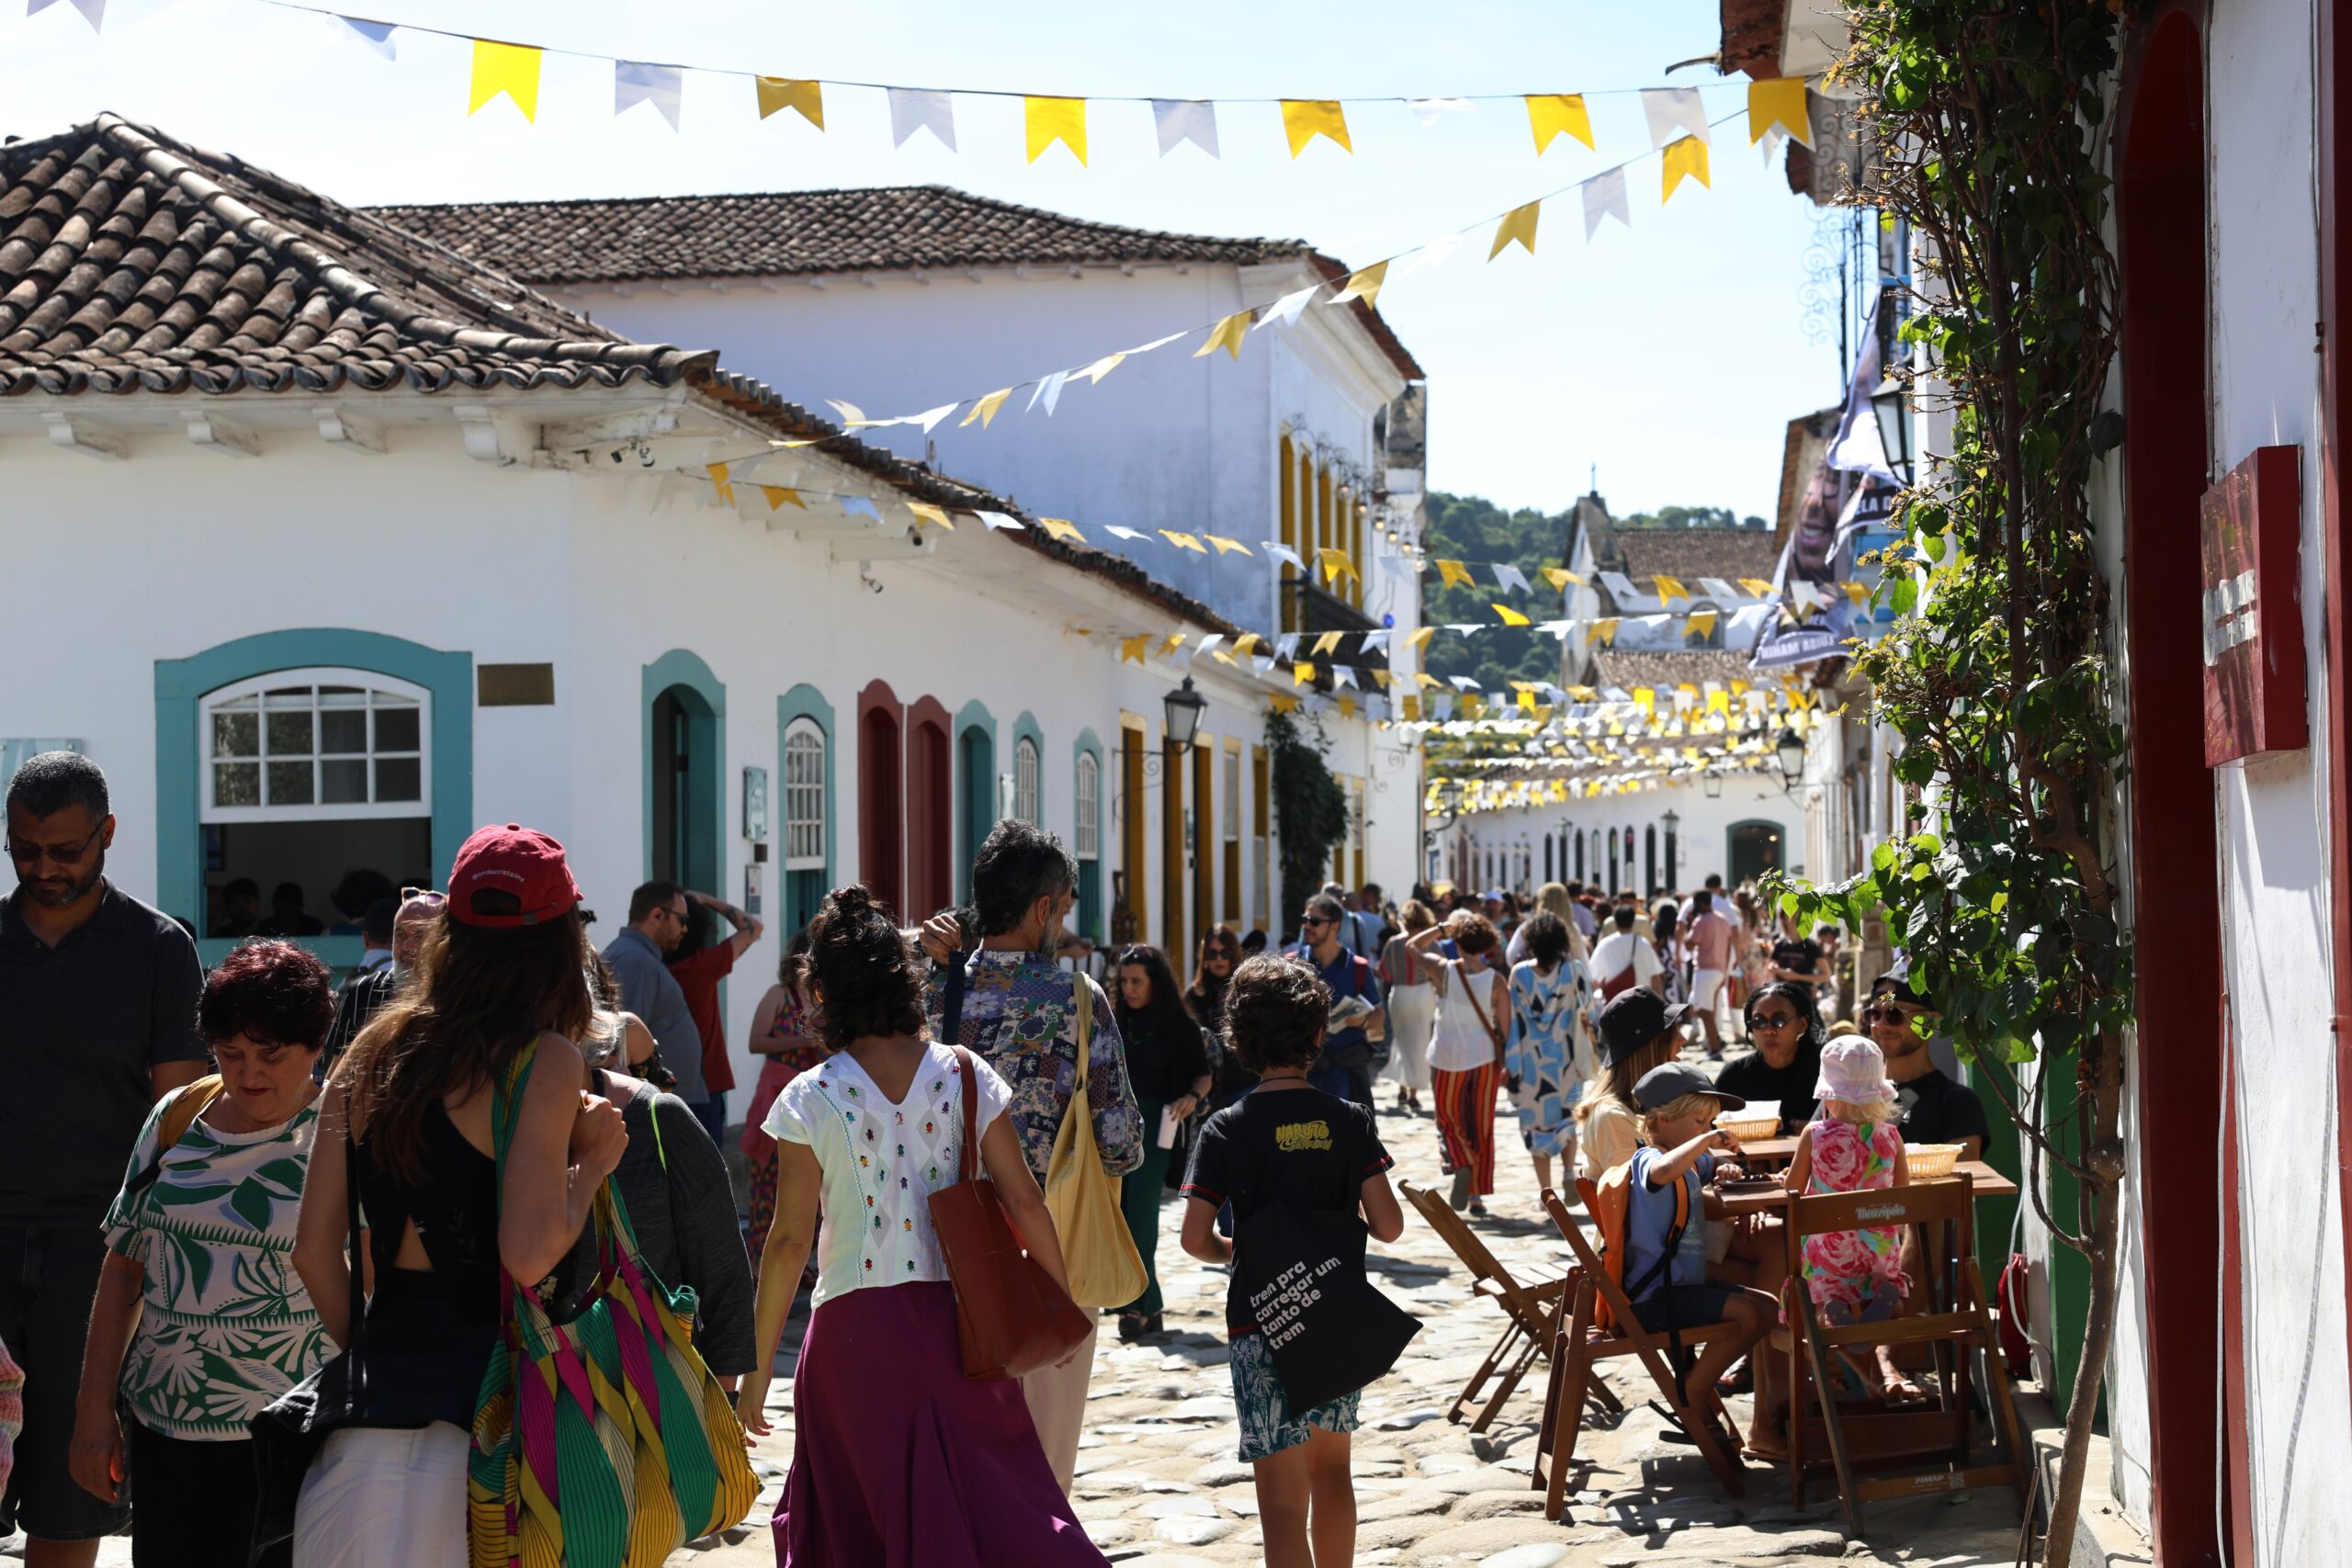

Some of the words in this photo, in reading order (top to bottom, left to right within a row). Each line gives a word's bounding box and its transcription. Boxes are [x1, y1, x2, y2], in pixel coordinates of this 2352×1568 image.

[1275, 1121, 1329, 1144] NARUTO
[1255, 1272, 1314, 1323] carregar
[1315, 1257, 1341, 1277] um
[1276, 1260, 1306, 1290] pra
[1261, 1304, 1300, 1337] tanto
[1300, 1289, 1321, 1308] de
[1269, 1321, 1306, 1350] trem
